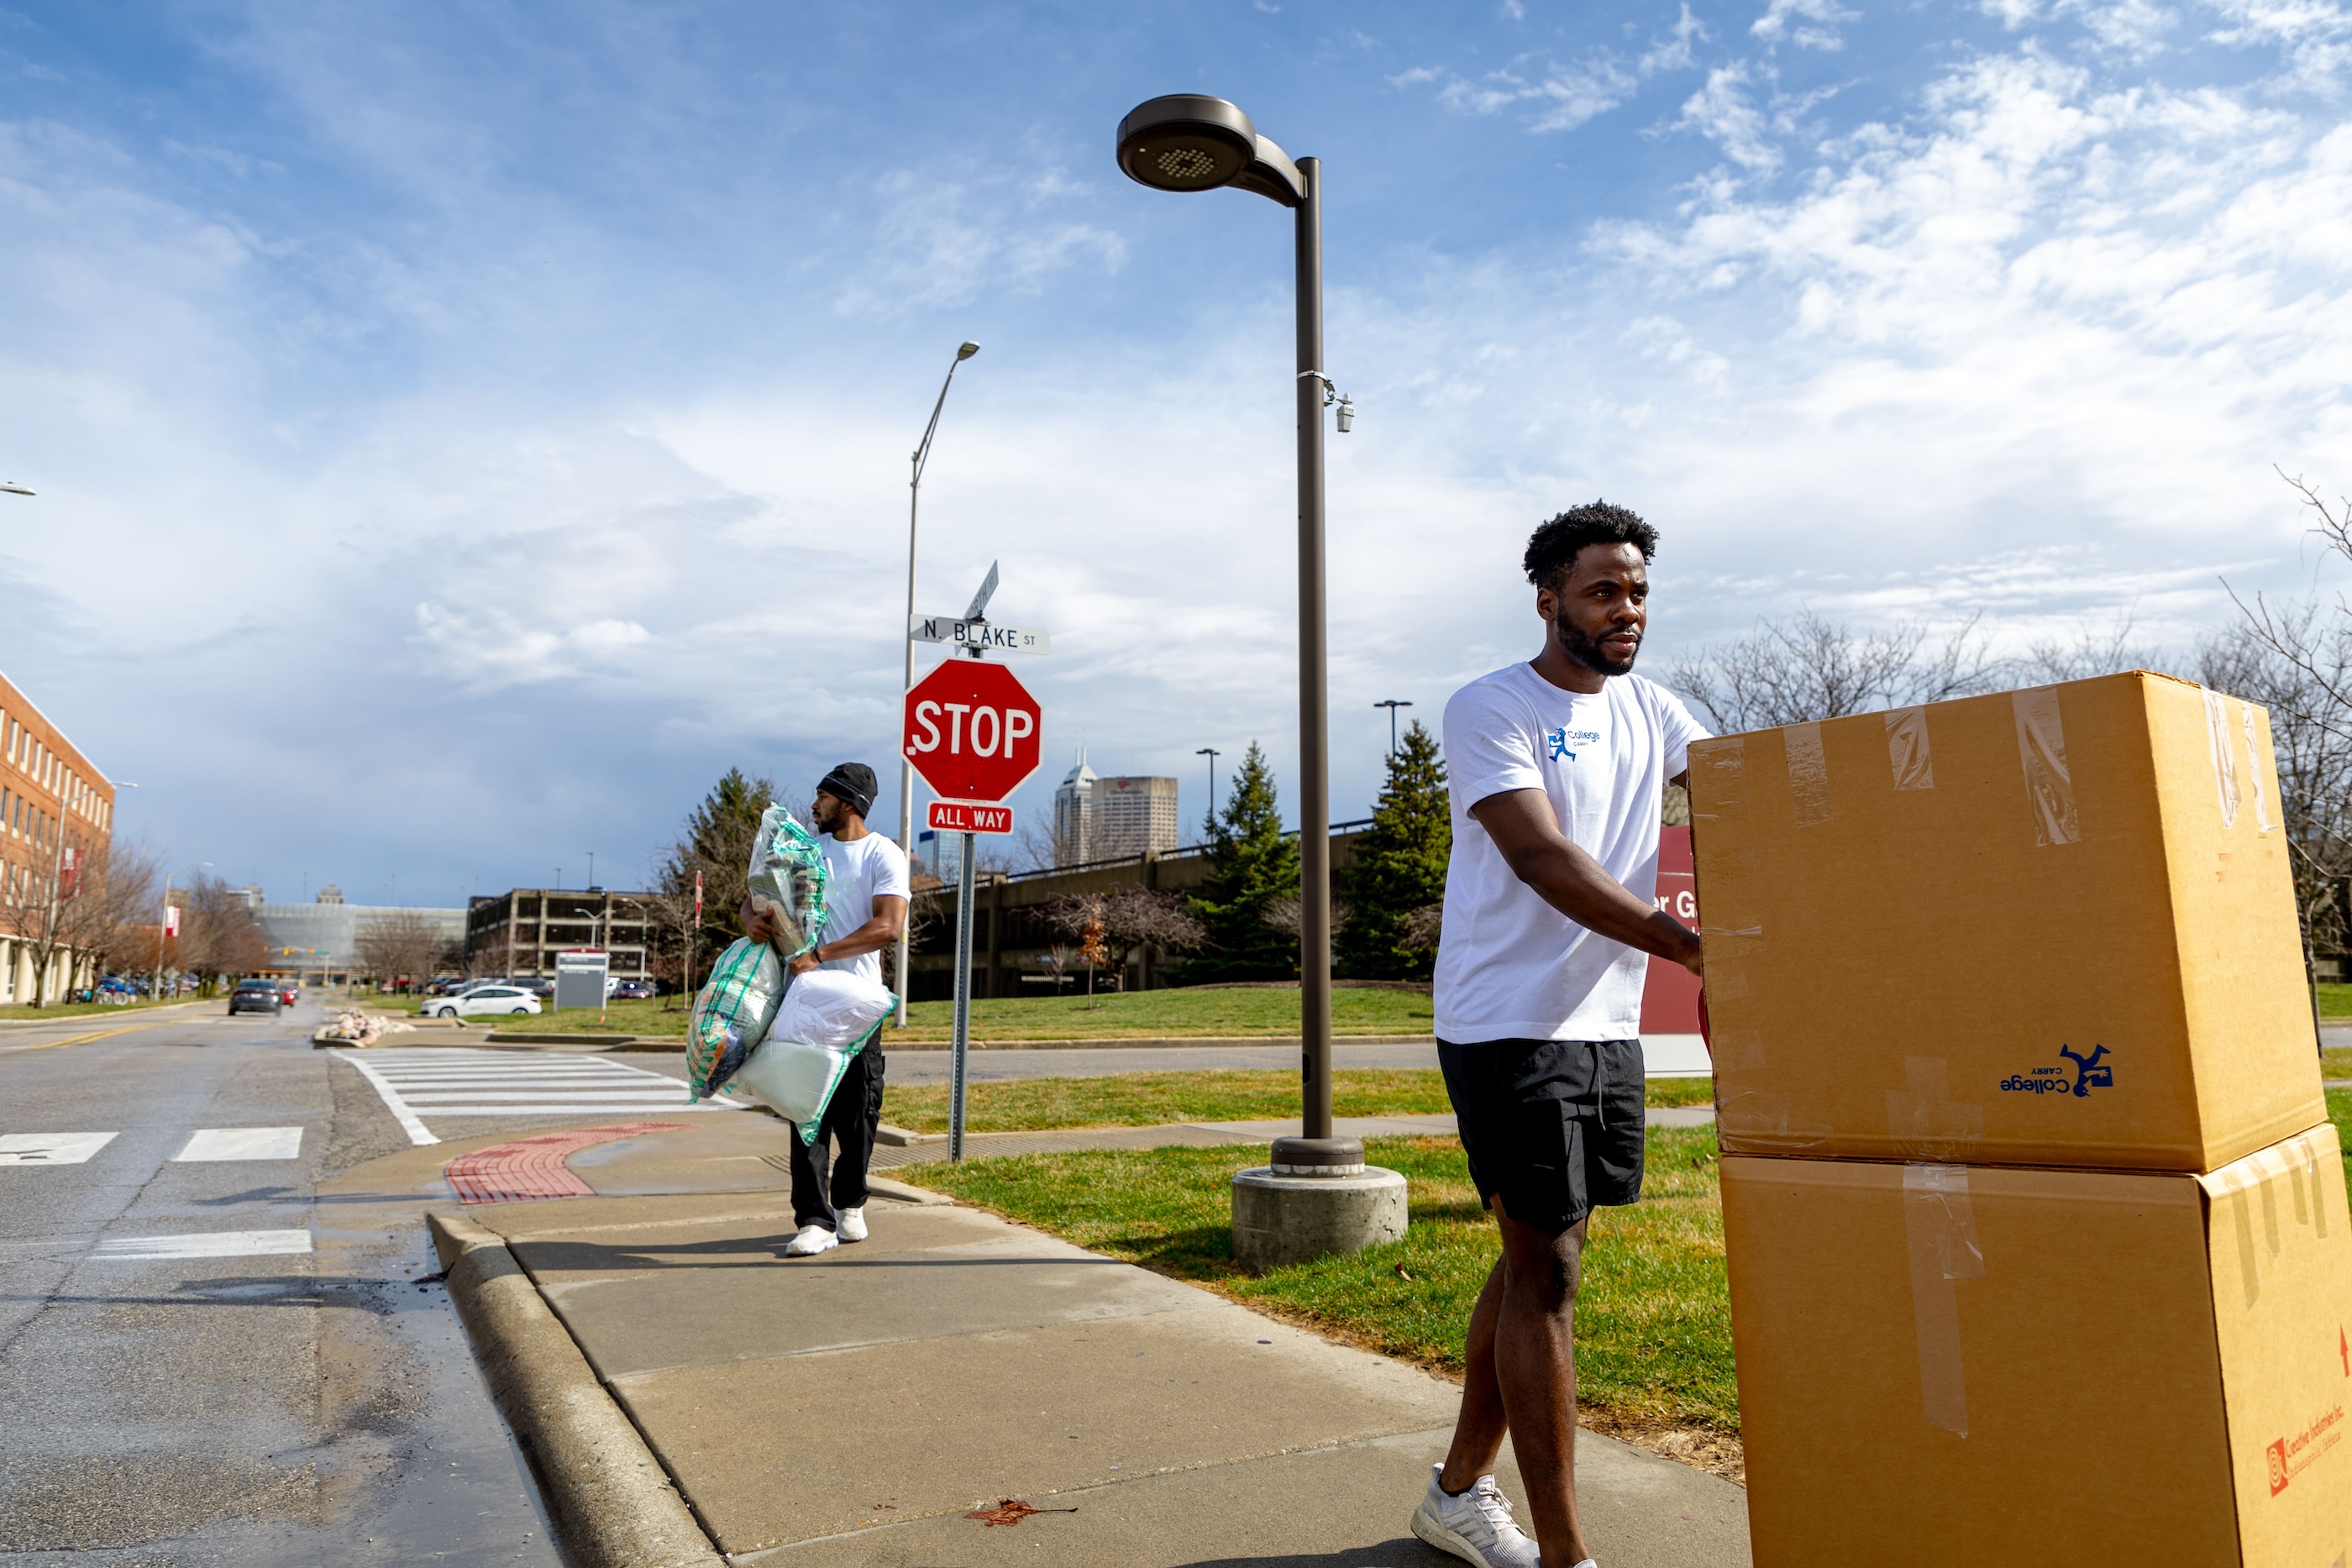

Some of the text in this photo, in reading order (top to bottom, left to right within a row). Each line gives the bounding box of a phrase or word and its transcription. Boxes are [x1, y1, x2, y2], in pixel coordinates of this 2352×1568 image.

[925, 619, 1036, 648] N. BLAKE ST
[911, 700, 1034, 759] STOP
[1567, 731, 1600, 742] College
[935, 807, 1005, 828] ALL WAY
[2000, 1075, 2070, 1094] College
[2286, 1403, 2344, 1459] Creative Industries Inc.
